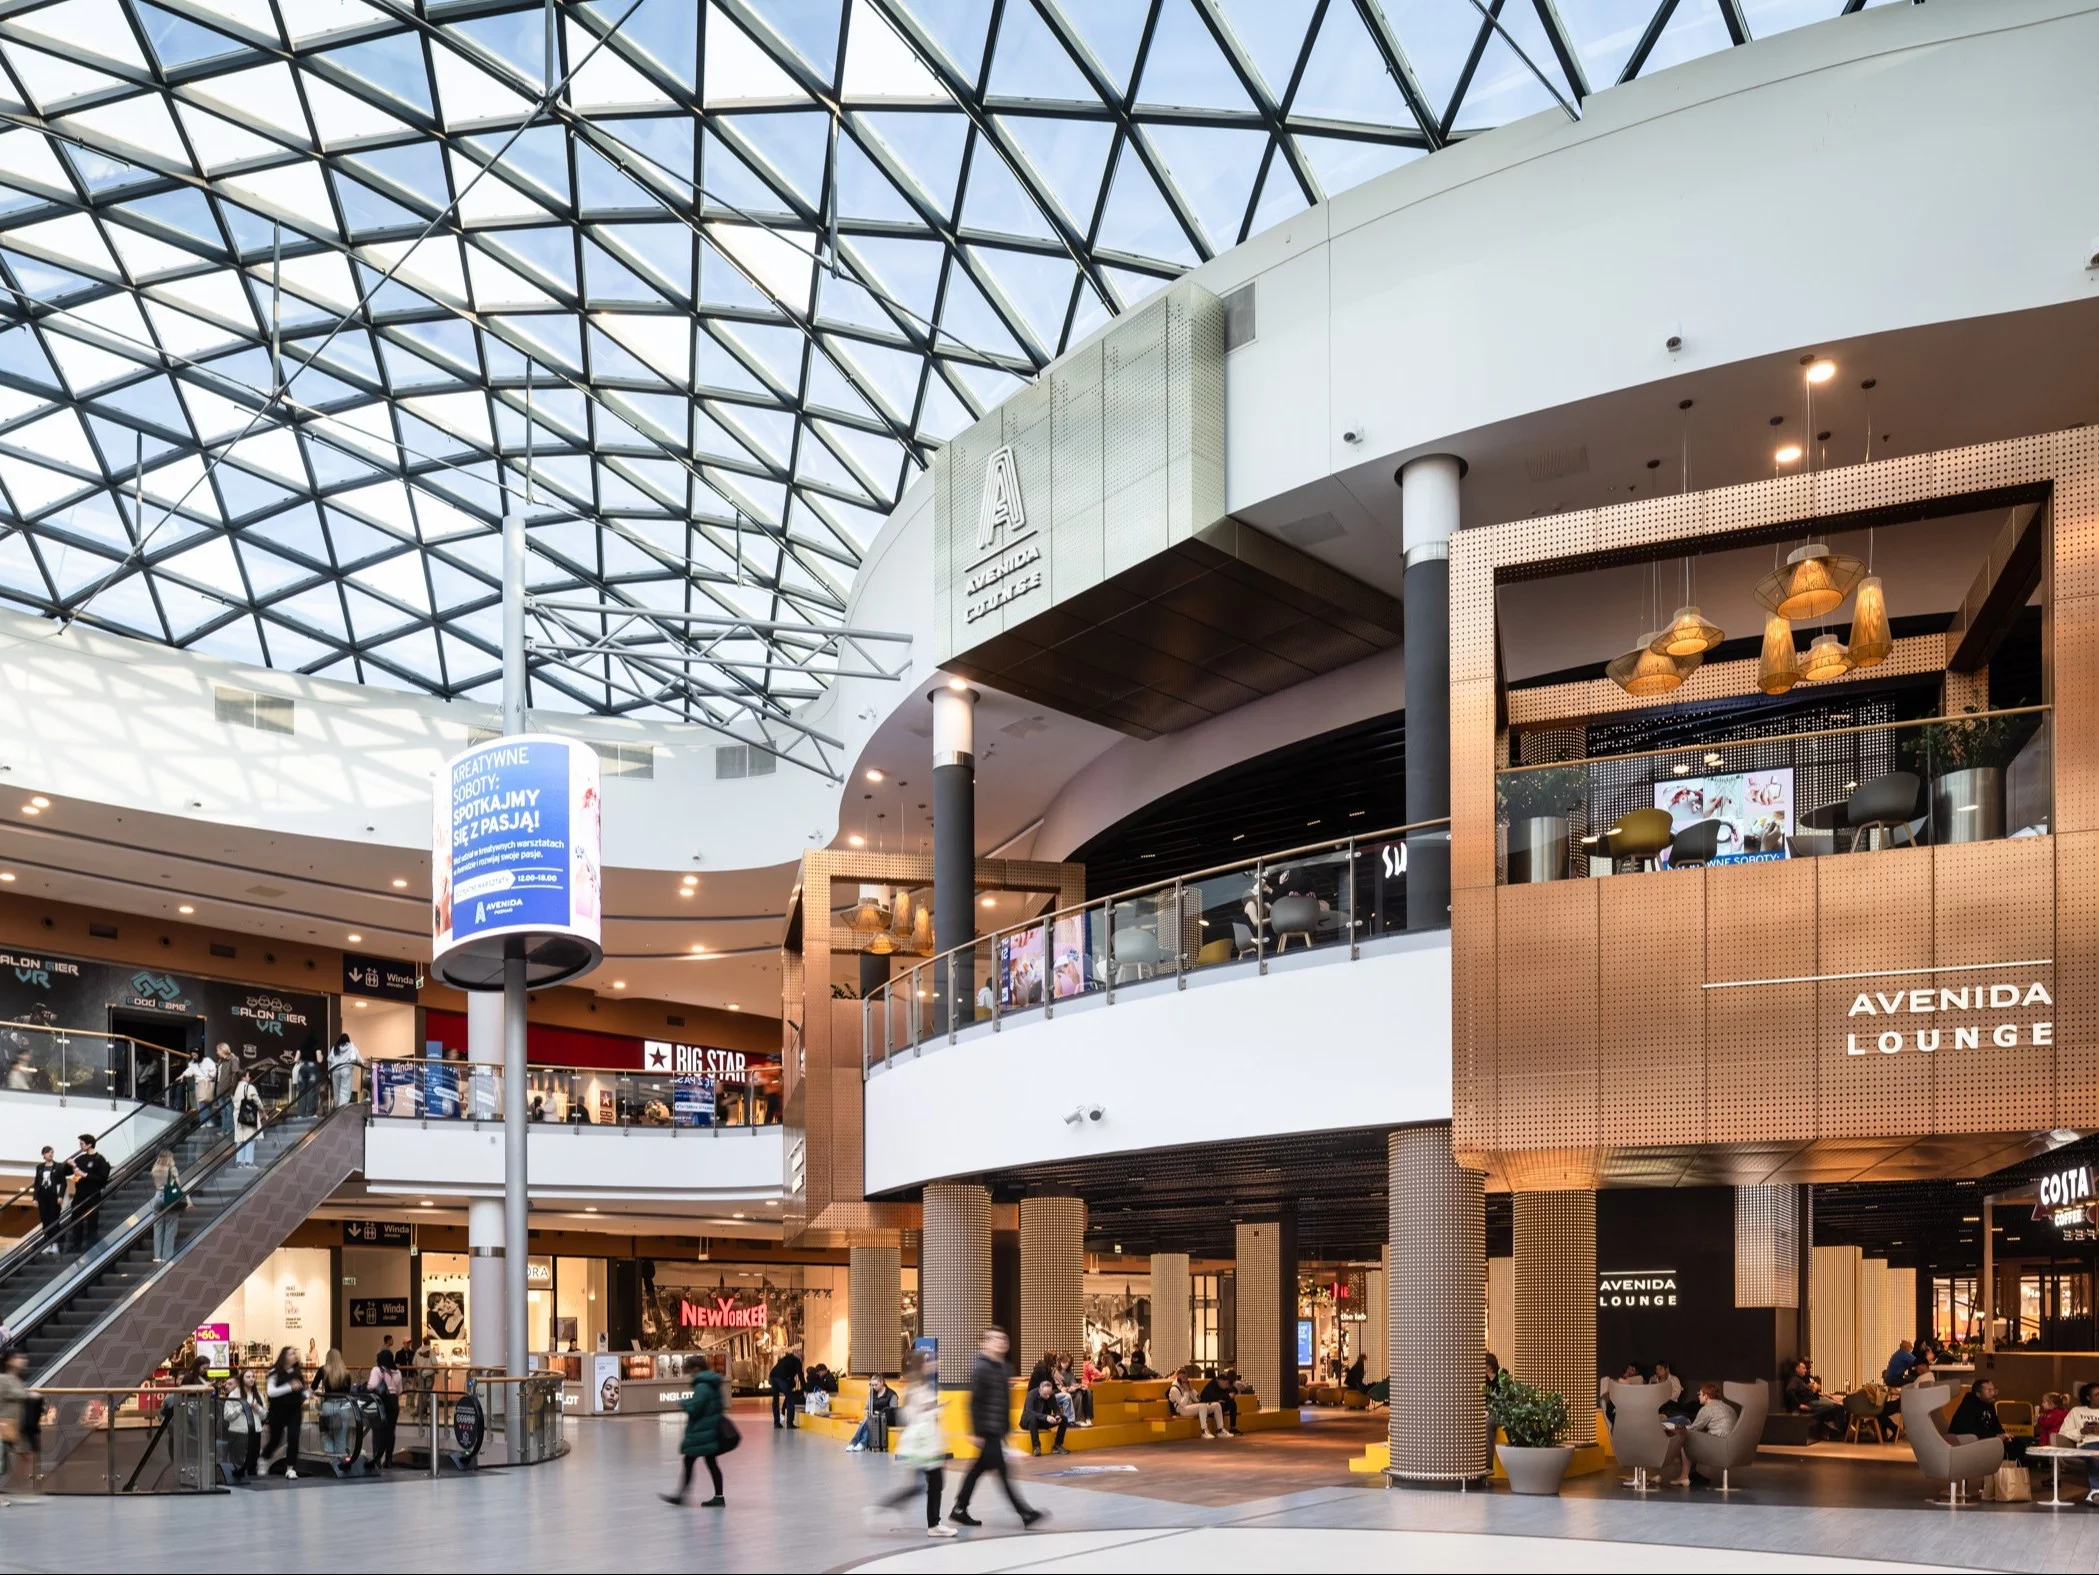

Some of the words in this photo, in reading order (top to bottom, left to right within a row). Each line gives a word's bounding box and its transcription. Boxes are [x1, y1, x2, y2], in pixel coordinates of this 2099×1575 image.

[966, 546, 1041, 597] AVENIDA
[966, 572, 1041, 624] LOUNGE
[453, 746, 530, 785] KREATYWNE
[453, 773, 500, 806] SOBOTY:
[453, 789, 541, 826] SPOTKAJMY
[453, 825, 469, 847] SIĘ
[470, 821, 479, 840] Z
[481, 810, 540, 836] PASJĄ!
[479, 841, 516, 855] kreatywnych
[516, 838, 565, 849] warsztatach
[501, 852, 520, 862] swoje
[520, 850, 543, 860] pasje.
[486, 898, 523, 911] AVENIDA
[15, 967, 51, 989] VR
[45, 961, 80, 976] GIER
[386, 972, 414, 985] Winda
[1847, 982, 2053, 1017] AVENIDA
[231, 1006, 275, 1020] SALON
[278, 1012, 307, 1027] GIER
[256, 1019, 284, 1037] VR
[1847, 1022, 2053, 1056] LOUNGE
[676, 1044, 703, 1078] BIG
[706, 1048, 746, 1083] STAR
[2040, 1166, 2089, 1206] COSTA
[2054, 1208, 2086, 1227] COFFEE
[384, 1224, 410, 1234] Winda
[1600, 1278, 1677, 1291] AVENIDA
[383, 1303, 405, 1314] Winda
[1600, 1295, 1677, 1307] LOUNGE
[1340, 1312, 1354, 1321] the
[1354, 1312, 1367, 1321] lab
[659, 1391, 695, 1402] INGLOT
